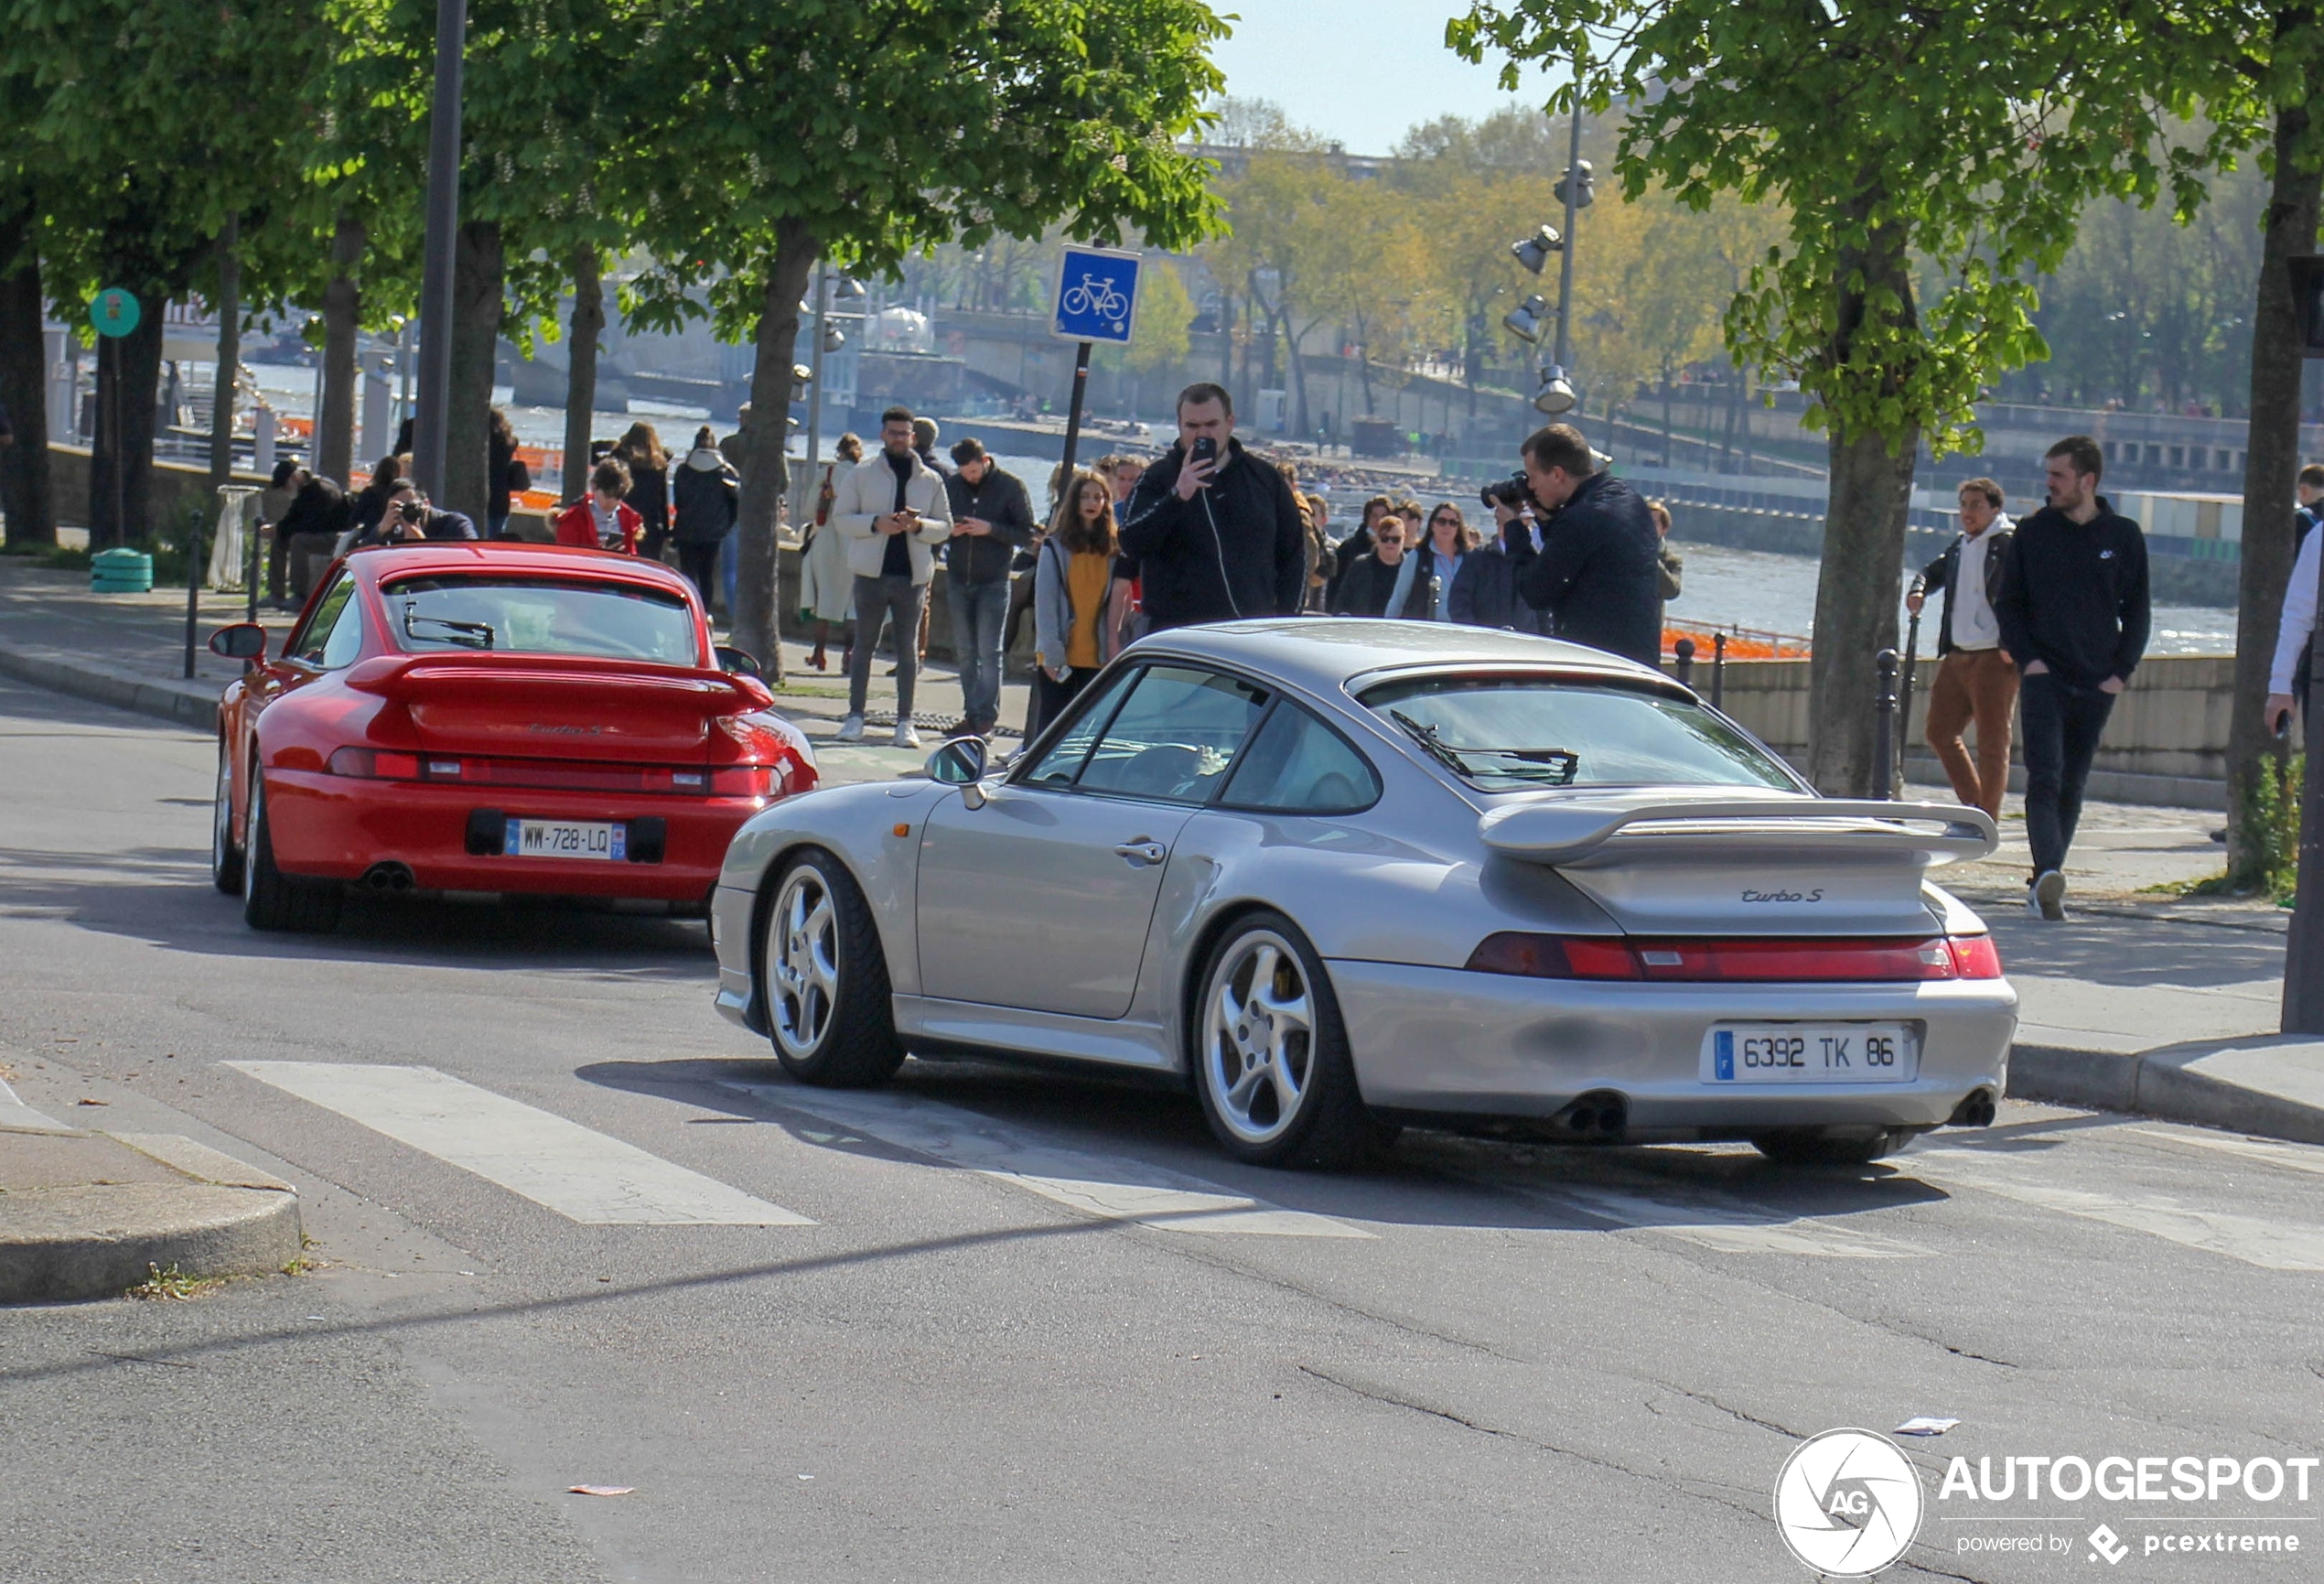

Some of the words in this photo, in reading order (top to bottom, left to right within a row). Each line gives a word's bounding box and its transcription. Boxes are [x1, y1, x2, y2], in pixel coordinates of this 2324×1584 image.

[524, 825, 608, 853] WW-728-LQ
[612, 844, 625, 856] 75
[1742, 889, 1802, 902] turbo
[1805, 888, 1824, 902] S
[1744, 1037, 1805, 1068] 6392
[1819, 1037, 1851, 1068] TK
[1867, 1038, 1895, 1068] 86
